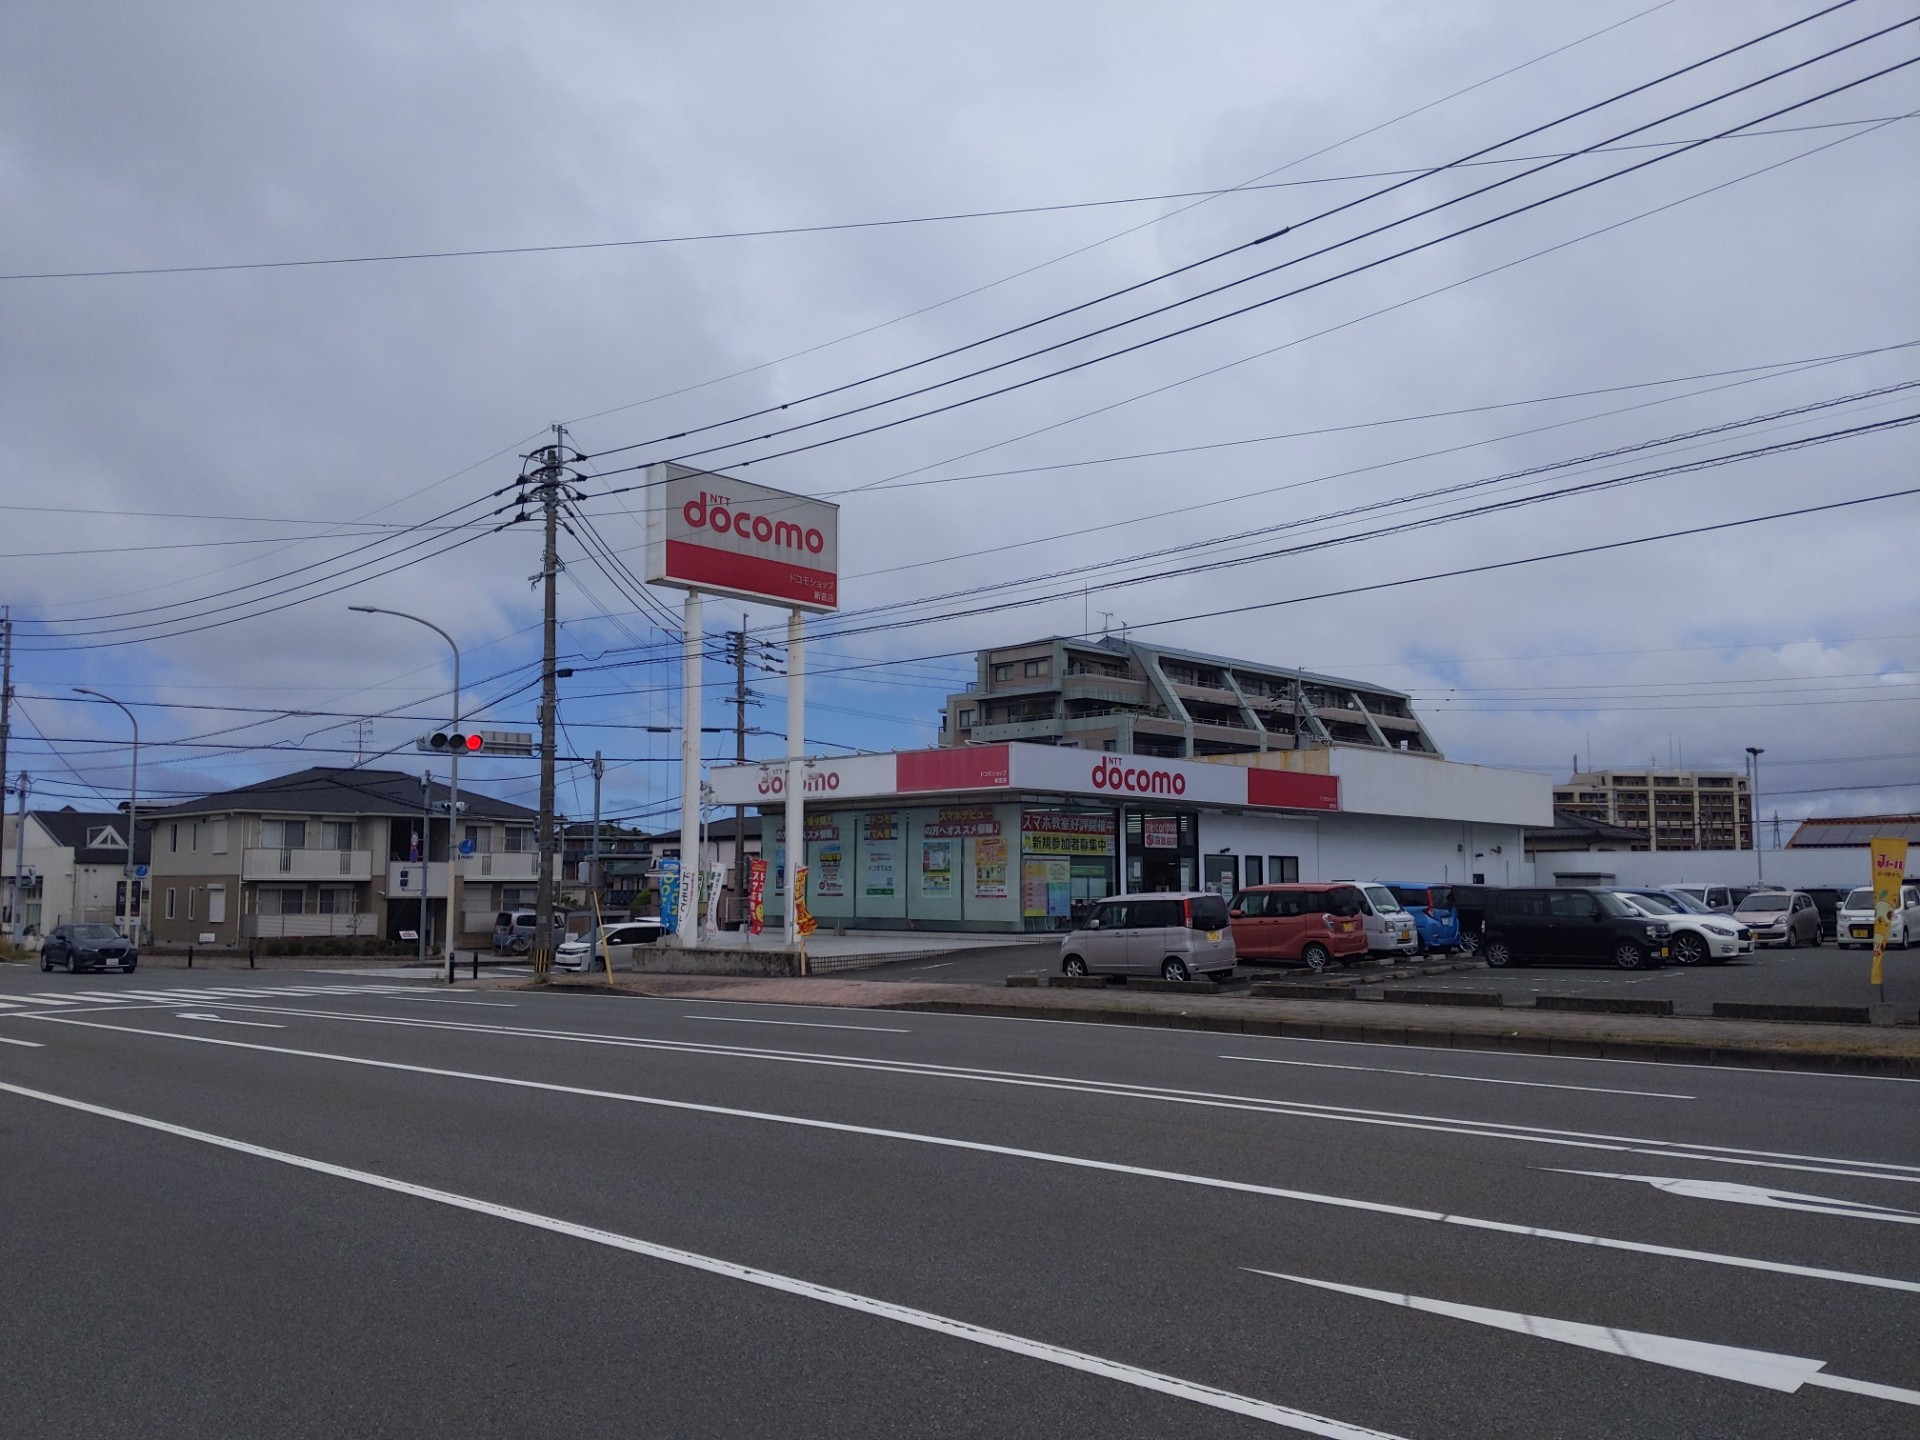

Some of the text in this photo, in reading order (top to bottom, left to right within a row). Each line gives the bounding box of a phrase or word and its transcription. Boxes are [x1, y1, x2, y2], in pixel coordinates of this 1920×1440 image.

[710, 493, 731, 506] NTT
[683, 491, 824, 554] docomo
[789, 573, 835, 590] ドコモショップ
[1108, 757, 1122, 766] NTT
[1091, 756, 1186, 795] docomo
[939, 809, 993, 821] スマホデビュー
[1023, 815, 1115, 834] スマホ教室好評開催中
[1032, 836, 1107, 853] 新規参加者募集中
